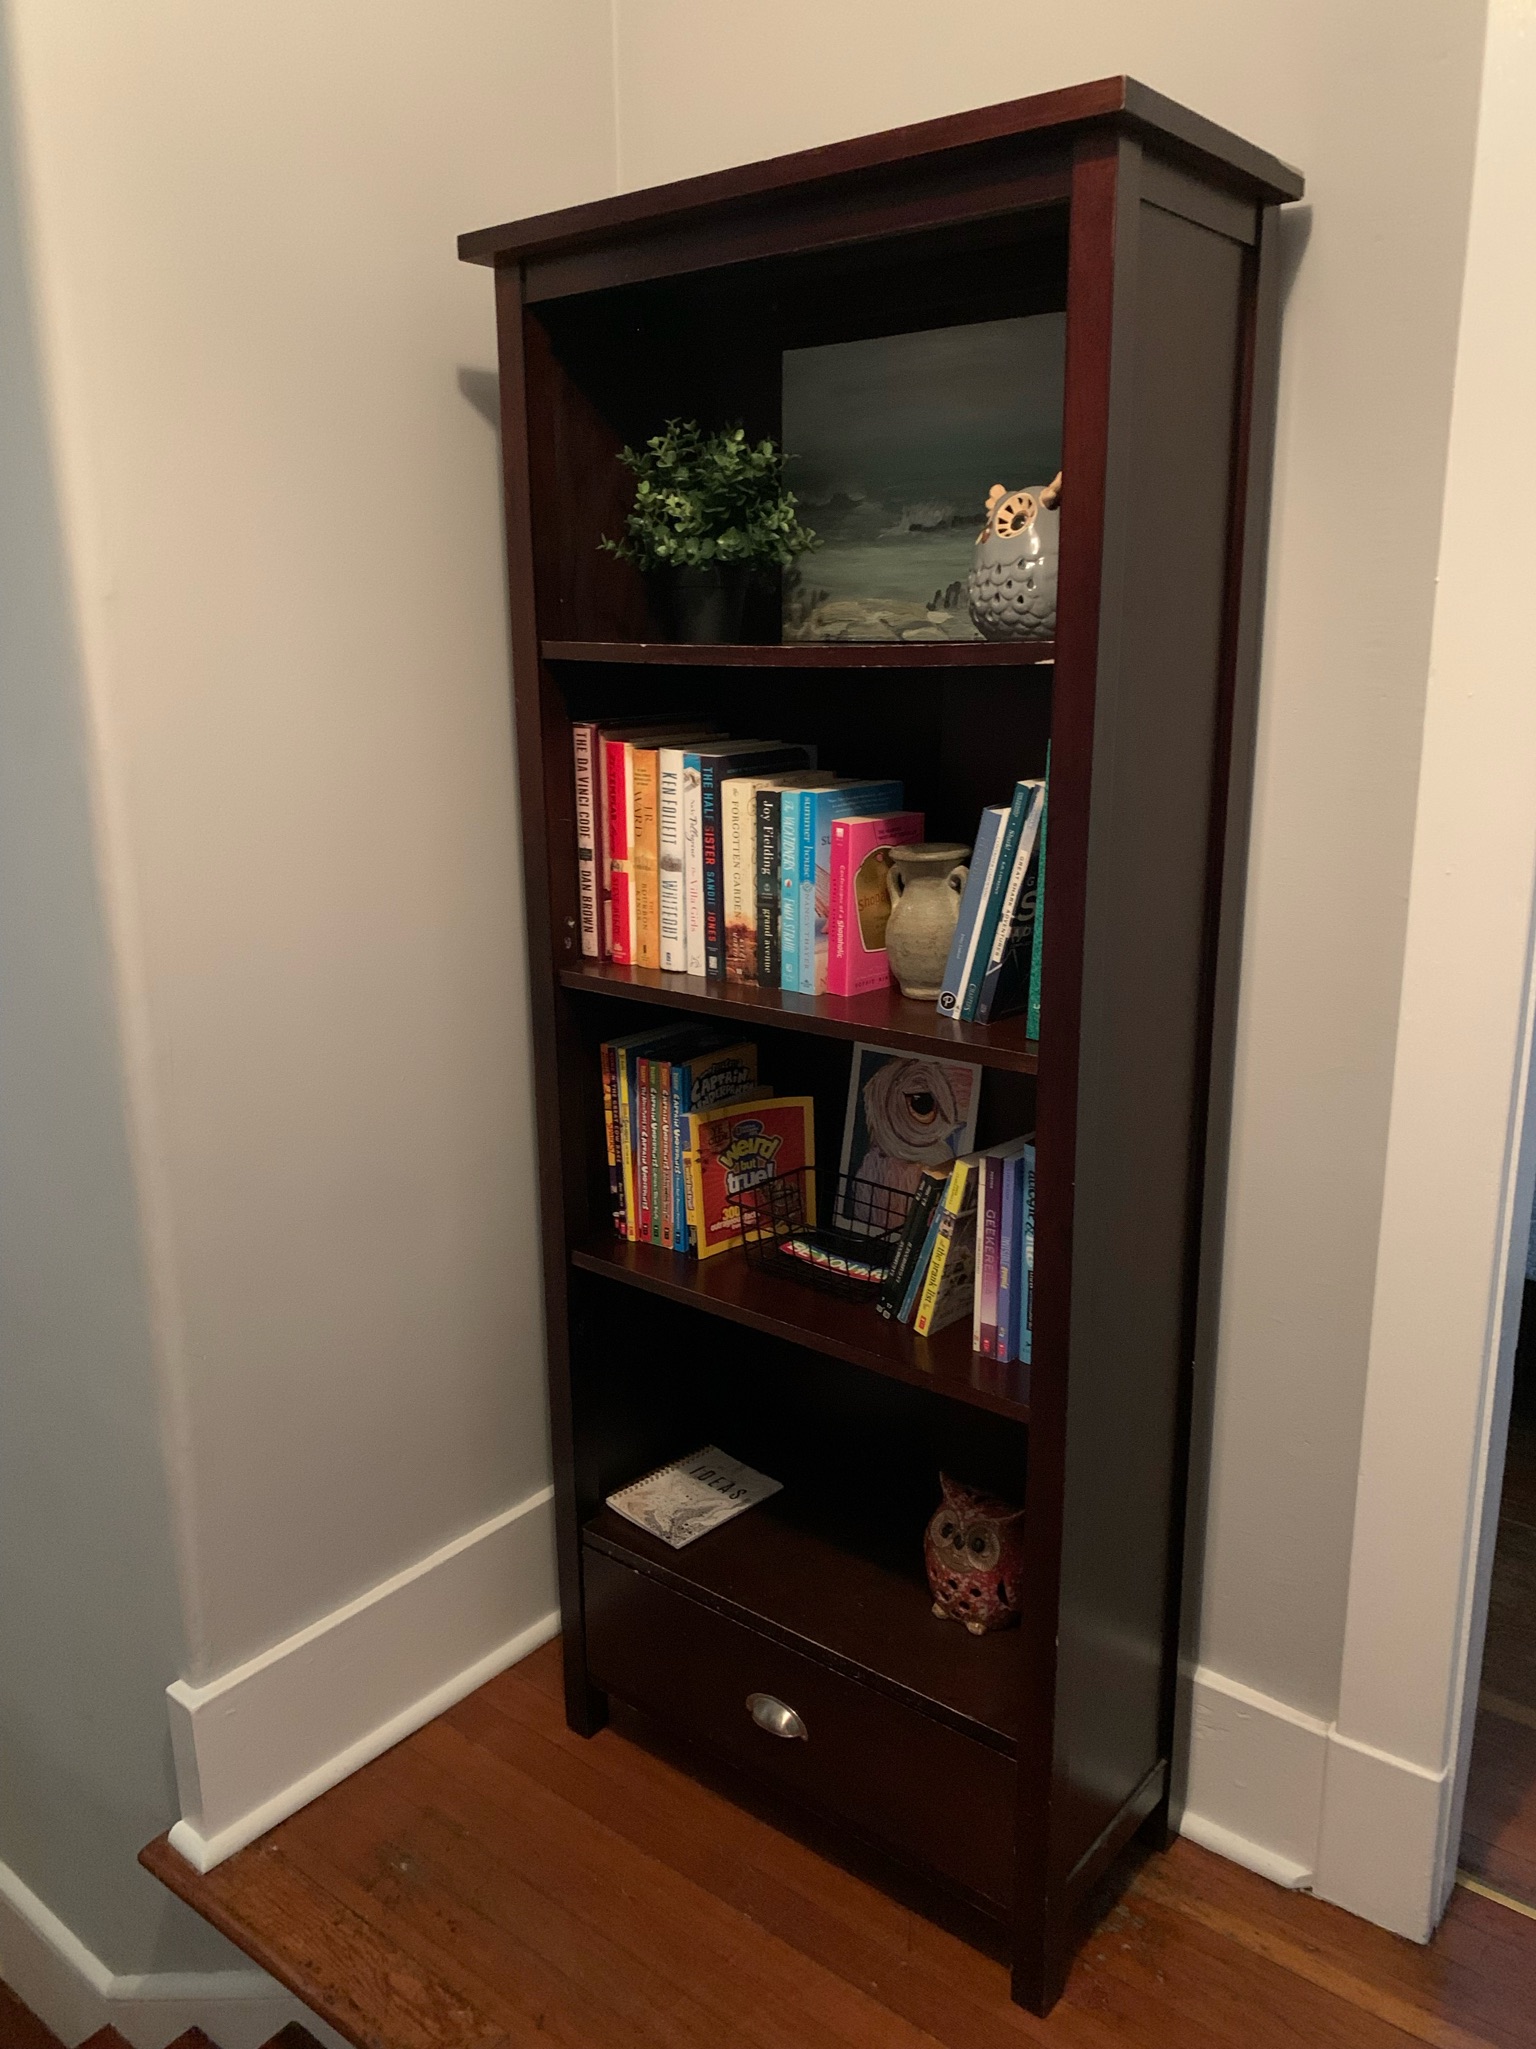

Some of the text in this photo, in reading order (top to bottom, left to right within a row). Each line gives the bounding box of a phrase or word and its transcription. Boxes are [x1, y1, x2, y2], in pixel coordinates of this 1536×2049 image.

[576, 733, 591, 839] THE DA VINCI CODE
[662, 772, 677, 845] KEN FOLLETT
[634, 791, 643, 837] WARD
[685, 816, 697, 858] Pellegrino
[703, 767, 716, 865] THE HALF SISTER
[731, 801, 741, 868] FORGOTTEN
[783, 800, 795, 871] The VACATIONERS
[804, 796, 814, 878] summer house
[760, 801, 774, 875] Joy Fielding
[1003, 829, 1016, 850] Shark!
[581, 870, 594, 933] DAN BROWN
[662, 880, 678, 941] WHITEOUT
[690, 879, 698, 904] Villa
[707, 871, 717, 942] SANDIE JONES
[733, 872, 742, 919] GARDEN
[994, 856, 1025, 957] GREAT SHARK ADVENTURES
[612, 908, 620, 934] BERRY
[690, 906, 699, 932] Girls
[762, 908, 773, 973] grand avenue
[783, 898, 794, 952] EMMA STRAUB
[836, 920, 844, 958] Shopaholic
[650, 1087, 658, 1121] CAPTAIN
[692, 1068, 749, 1103] CAPTAIN
[672, 1094, 680, 1127] CAPTAIN
[720, 1136, 780, 1167] weird
[742, 1159, 756, 1170] but
[727, 1162, 774, 1193] true!
[722, 1206, 740, 1219] 300
[924, 1246, 947, 1303] the prank list
[984, 1209, 996, 1294] GEEKERELLA
[689, 1465, 747, 1500] IDEAS
